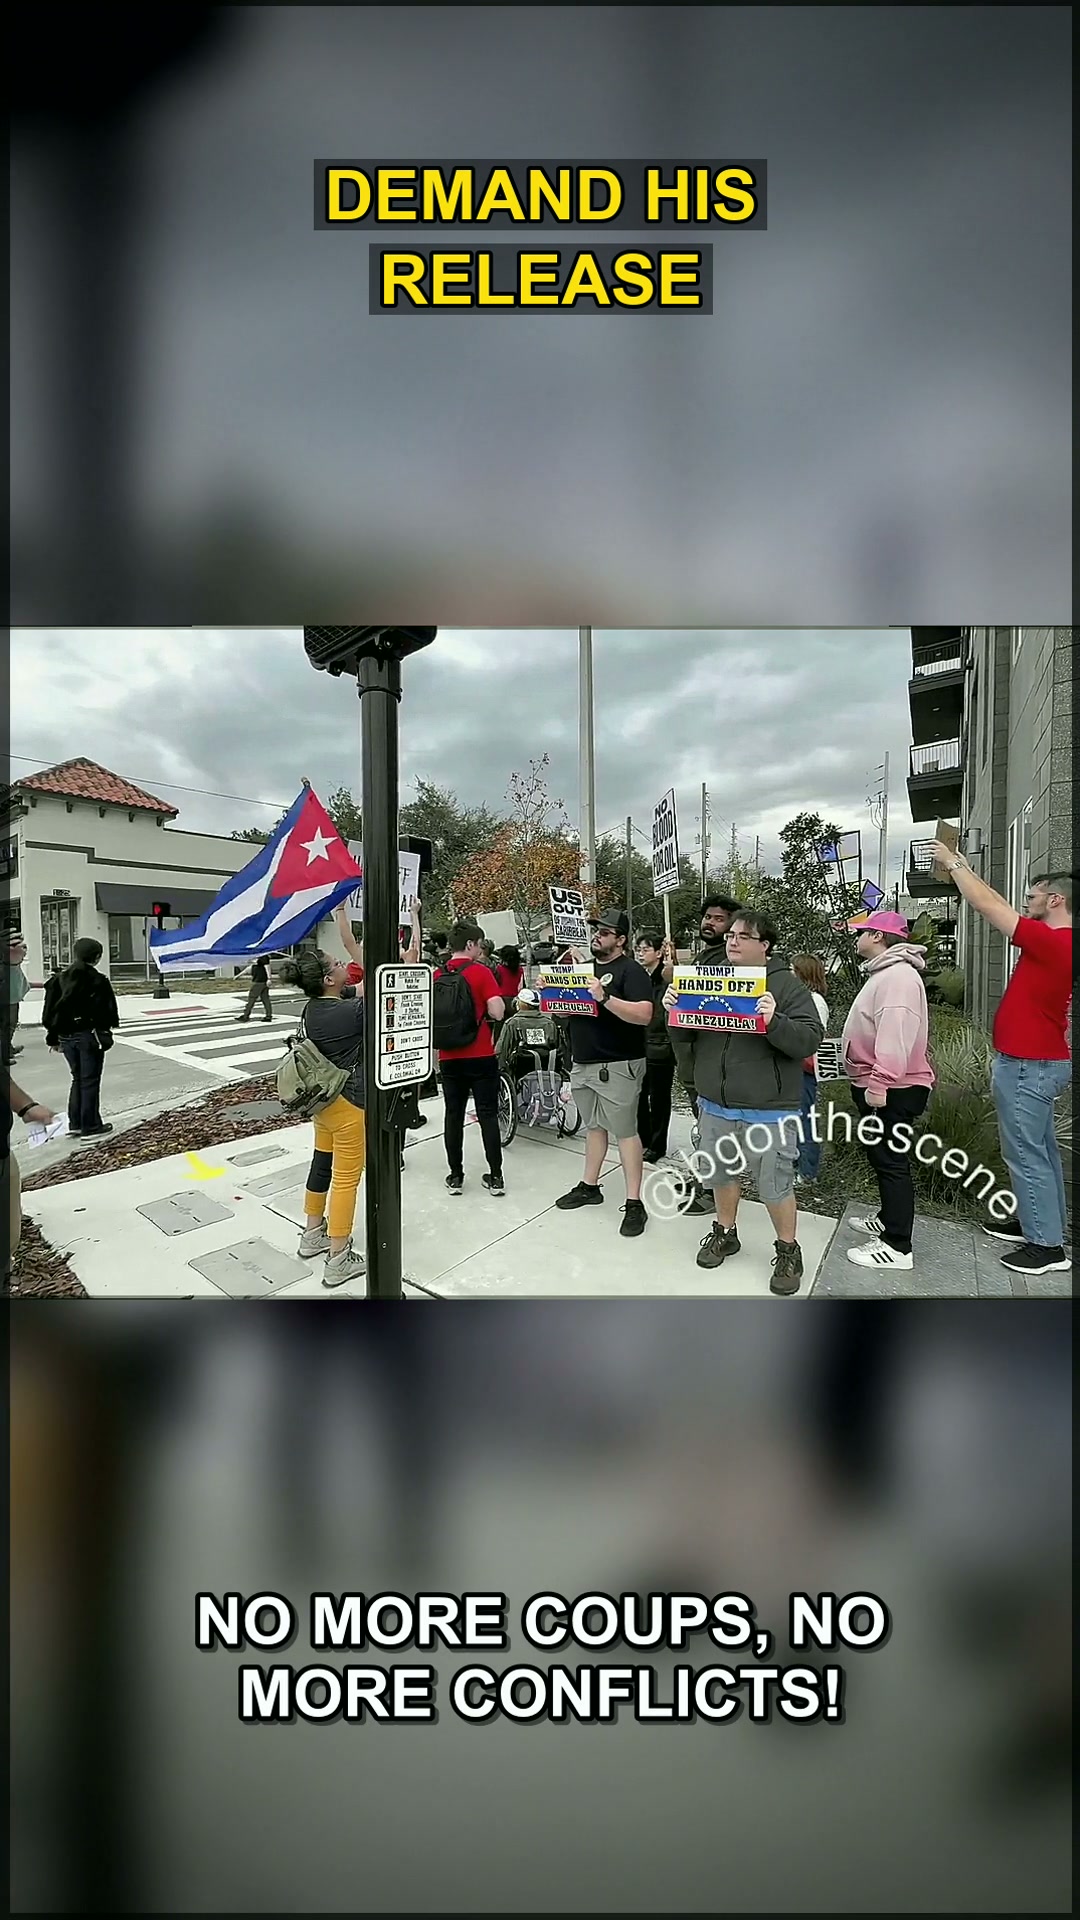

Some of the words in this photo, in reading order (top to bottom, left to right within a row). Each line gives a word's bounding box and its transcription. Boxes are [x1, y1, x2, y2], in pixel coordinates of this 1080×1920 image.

[654, 798, 668, 820] NO
[652, 809, 674, 850] BLOOD
[653, 849, 664, 878] FOR
[664, 842, 676, 872] OIL
[551, 888, 582, 905] US
[553, 903, 583, 916] OUT
[550, 965, 575, 974] TRUMP!
[695, 966, 736, 977] TRUMP!
[544, 975, 570, 986] HANDS
[571, 975, 588, 986] OFF
[678, 979, 723, 992] HANDS
[727, 980, 756, 993] OFF
[546, 1001, 594, 1013] VENEZUELA!
[677, 1013, 757, 1030] VENEZUELA!
[404, 1051, 420, 1059] BUTTON
[817, 1042, 838, 1078] STAND
[402, 1062, 417, 1070] CROSS
[394, 1070, 414, 1079] COLONIAL
